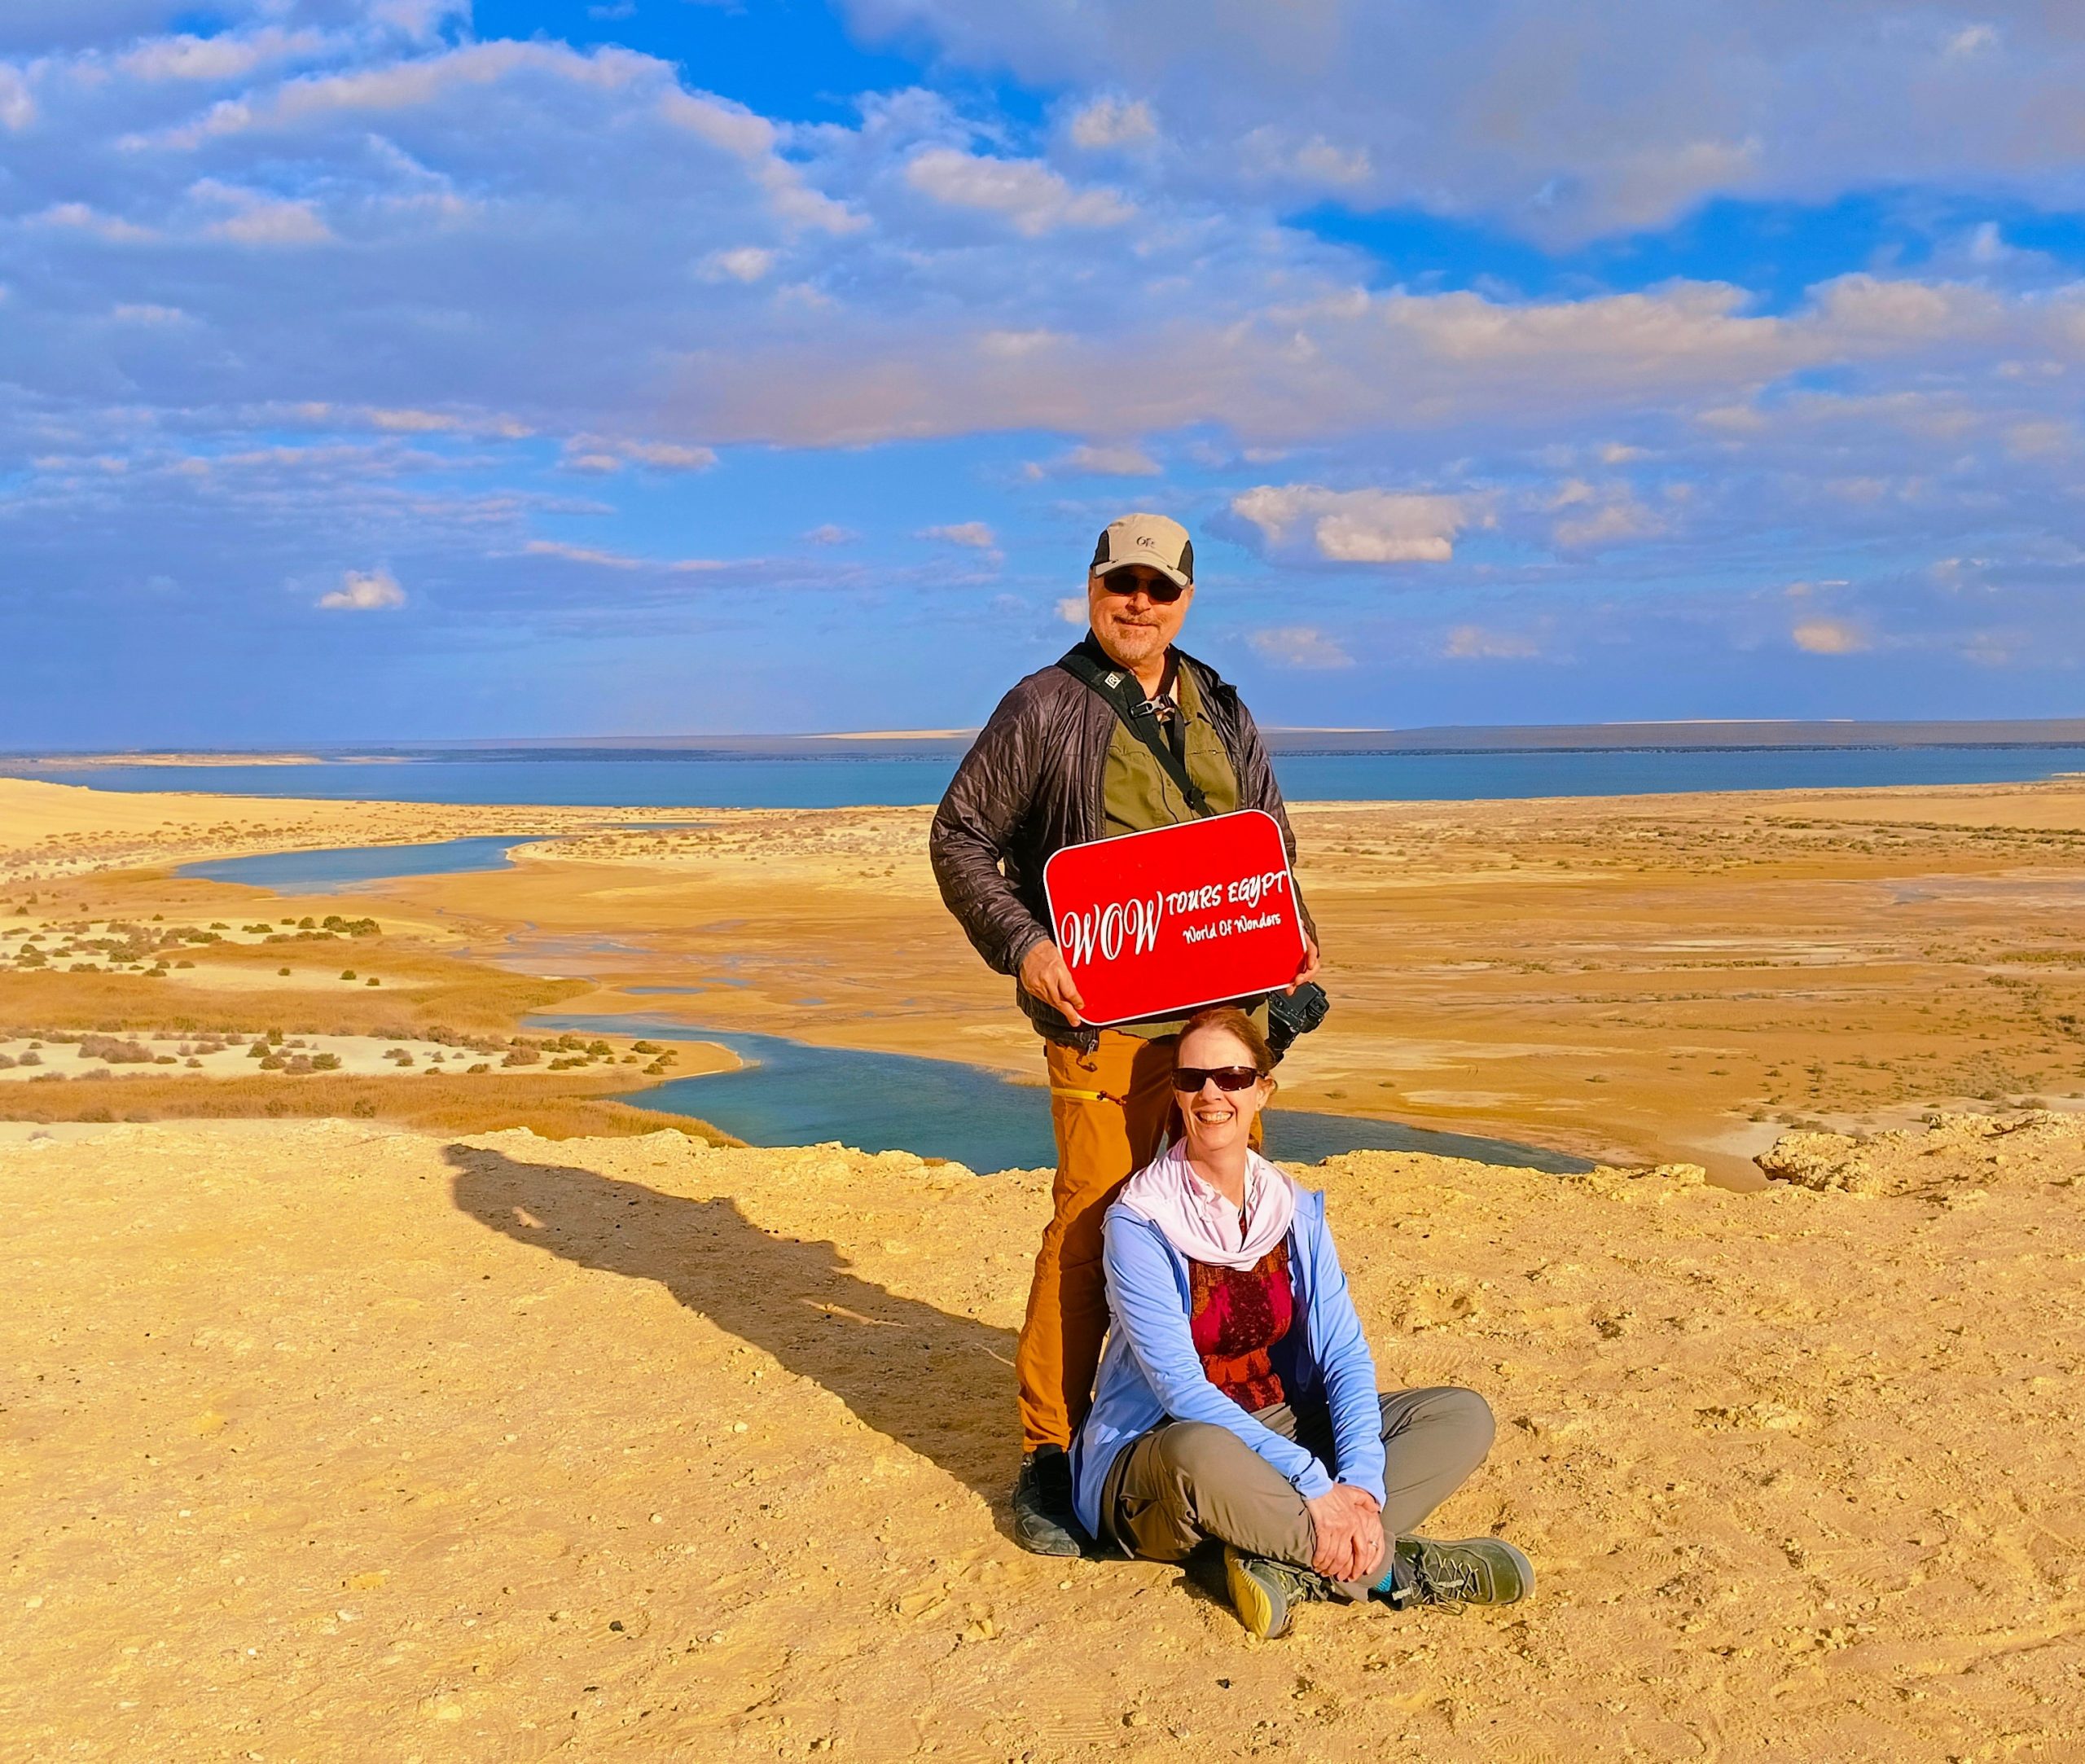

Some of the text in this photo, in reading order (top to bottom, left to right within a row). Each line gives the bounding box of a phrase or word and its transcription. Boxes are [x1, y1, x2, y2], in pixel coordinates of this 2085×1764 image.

[1061, 871, 1287, 968] WOW TOURS EGYPT
[1183, 913, 1281, 944] World Of Wonders
